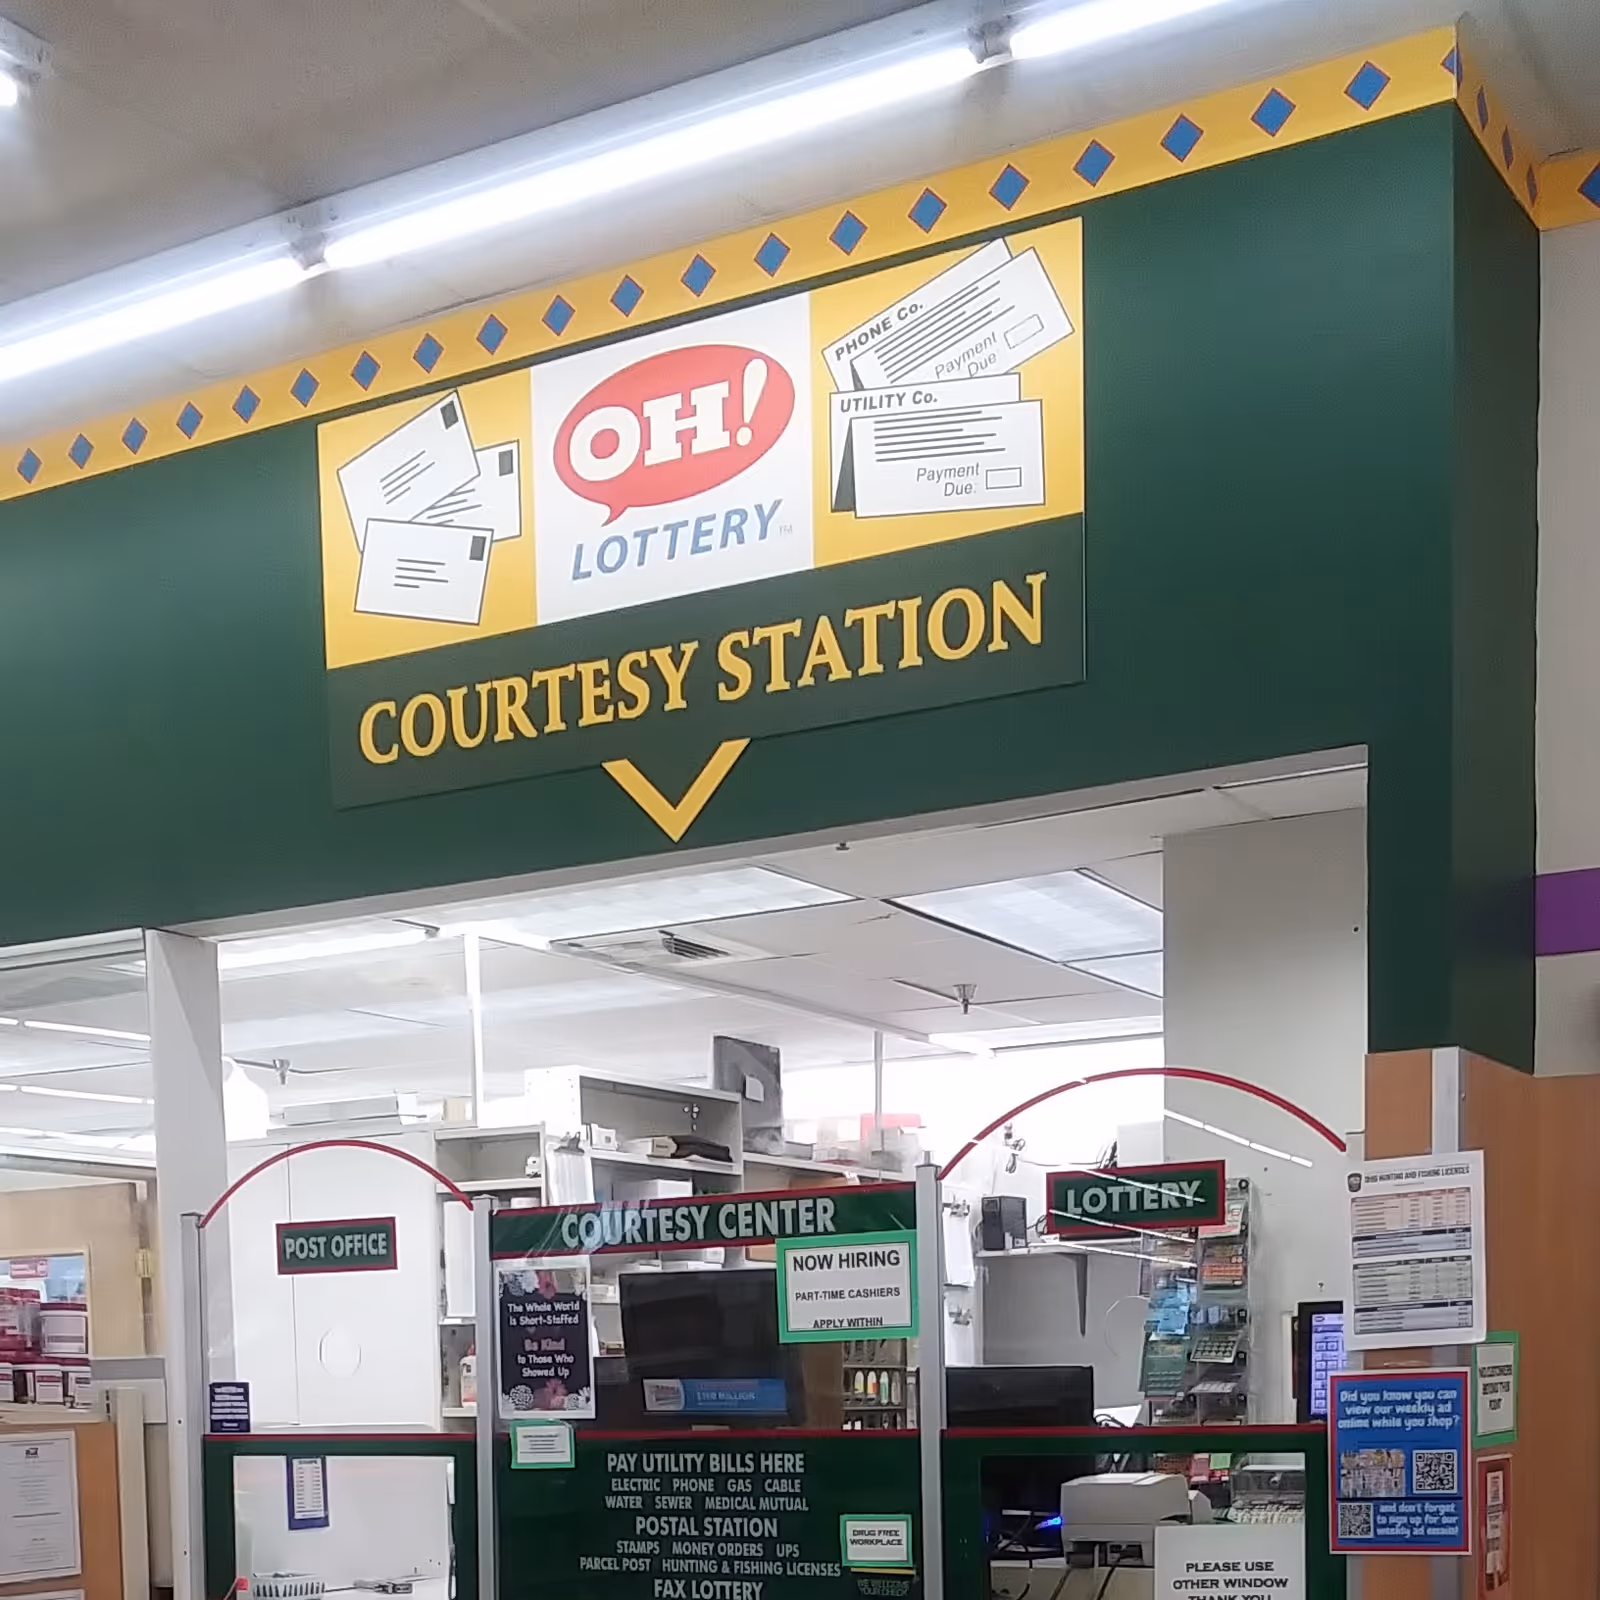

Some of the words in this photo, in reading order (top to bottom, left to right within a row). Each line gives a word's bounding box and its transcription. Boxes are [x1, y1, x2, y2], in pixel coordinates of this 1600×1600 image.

[835, 317, 892, 361] PHONE
[897, 303, 924, 323] Co.
[935, 332, 998, 379] Payment
[840, 392, 906, 413] UTILITY
[912, 390, 938, 405] Co.
[569, 357, 768, 482] OH!
[917, 462, 980, 483] Payment
[572, 499, 783, 581] LOTTERY
[358, 640, 699, 765] COURTESY
[717, 571, 1047, 702] STATION
[1405, 1171, 1417, 1180] AND
[1067, 1180, 1202, 1215] LOTTERY
[561, 1204, 711, 1248] COURTESY
[718, 1198, 836, 1239] CENTER
[285, 1236, 327, 1260] POST
[331, 1233, 387, 1258] OFFICE
[793, 1254, 833, 1271] NOW
[839, 1250, 900, 1268] HIRING
[795, 1290, 845, 1301] PART-TIME
[848, 1287, 900, 1299] CASHIERS
[508, 1303, 523, 1313] The
[525, 1302, 552, 1312] Whole
[554, 1301, 580, 1311] World
[520, 1314, 579, 1326] Short-Staffed
[813, 1319, 844, 1329] APPLY
[846, 1317, 883, 1327] WITHIN
[541, 1338, 565, 1350] Kind
[517, 1355, 526, 1364] to
[528, 1354, 552, 1364] Those
[555, 1354, 574, 1363] Who
[522, 1367, 554, 1377] Showed
[558, 1367, 570, 1379] Up
[1340, 1390, 1358, 1402] Did
[1360, 1393, 1380, 1405] you
[1383, 1390, 1412, 1400] know
[1415, 1392, 1434, 1404] you
[1437, 1390, 1457, 1400] can
[1345, 1404, 1371, 1415] view
[1374, 1406, 1393, 1414] our
[1396, 1402, 1435, 1416] weekly
[1437, 1402, 1451, 1413] ad
[1372, 1416, 1402, 1427] while
[1404, 1419, 1425, 1430] you
[1427, 1415, 1460, 1430] shop?
[607, 1453, 638, 1473] PAY
[643, 1453, 704, 1473] UTILITY
[709, 1453, 754, 1473] BILLS
[760, 1453, 805, 1474] HERE
[611, 1478, 661, 1492] ELECTRIC
[673, 1478, 714, 1492] PHONE
[727, 1479, 752, 1493] GAS
[764, 1478, 801, 1493] CABLE
[605, 1496, 643, 1509] WATER
[655, 1496, 692, 1510] SEWER
[705, 1497, 755, 1511] MEDICAL
[759, 1497, 809, 1511] MUTUAL
[1379, 1503, 1397, 1513] and
[1398, 1502, 1422, 1513] don't
[1424, 1503, 1455, 1513] forget
[636, 1516, 699, 1536] POSTAL
[703, 1517, 778, 1537] STATION
[1376, 1515, 1387, 1524] to
[1409, 1516, 1420, 1526] up
[1424, 1514, 1439, 1524] for
[1441, 1515, 1459, 1524] our
[853, 1529, 876, 1537] DRUG
[878, 1529, 900, 1537] FREE
[1376, 1525, 1411, 1538] weekly
[1412, 1526, 1425, 1535] ad
[617, 1541, 660, 1555] STAMPS
[672, 1542, 715, 1556] MONEY
[717, 1542, 763, 1557] ORDERS
[776, 1543, 800, 1558] UPS
[850, 1538, 903, 1546] WORKPLACE
[580, 1557, 619, 1571] PARCEL
[622, 1557, 651, 1571] POST
[662, 1559, 717, 1573] HUNTING
[721, 1560, 730, 1574] &
[734, 1560, 783, 1576] FISHING
[786, 1562, 841, 1577] LICENSES
[1186, 1561, 1241, 1572] PLEASE
[1245, 1561, 1274, 1571] USE
[654, 1579, 686, 1598] FAX
[692, 1580, 763, 1600] LOTTERY
[1173, 1579, 1219, 1589] OTHER
[1223, 1578, 1289, 1588] WINDOW
